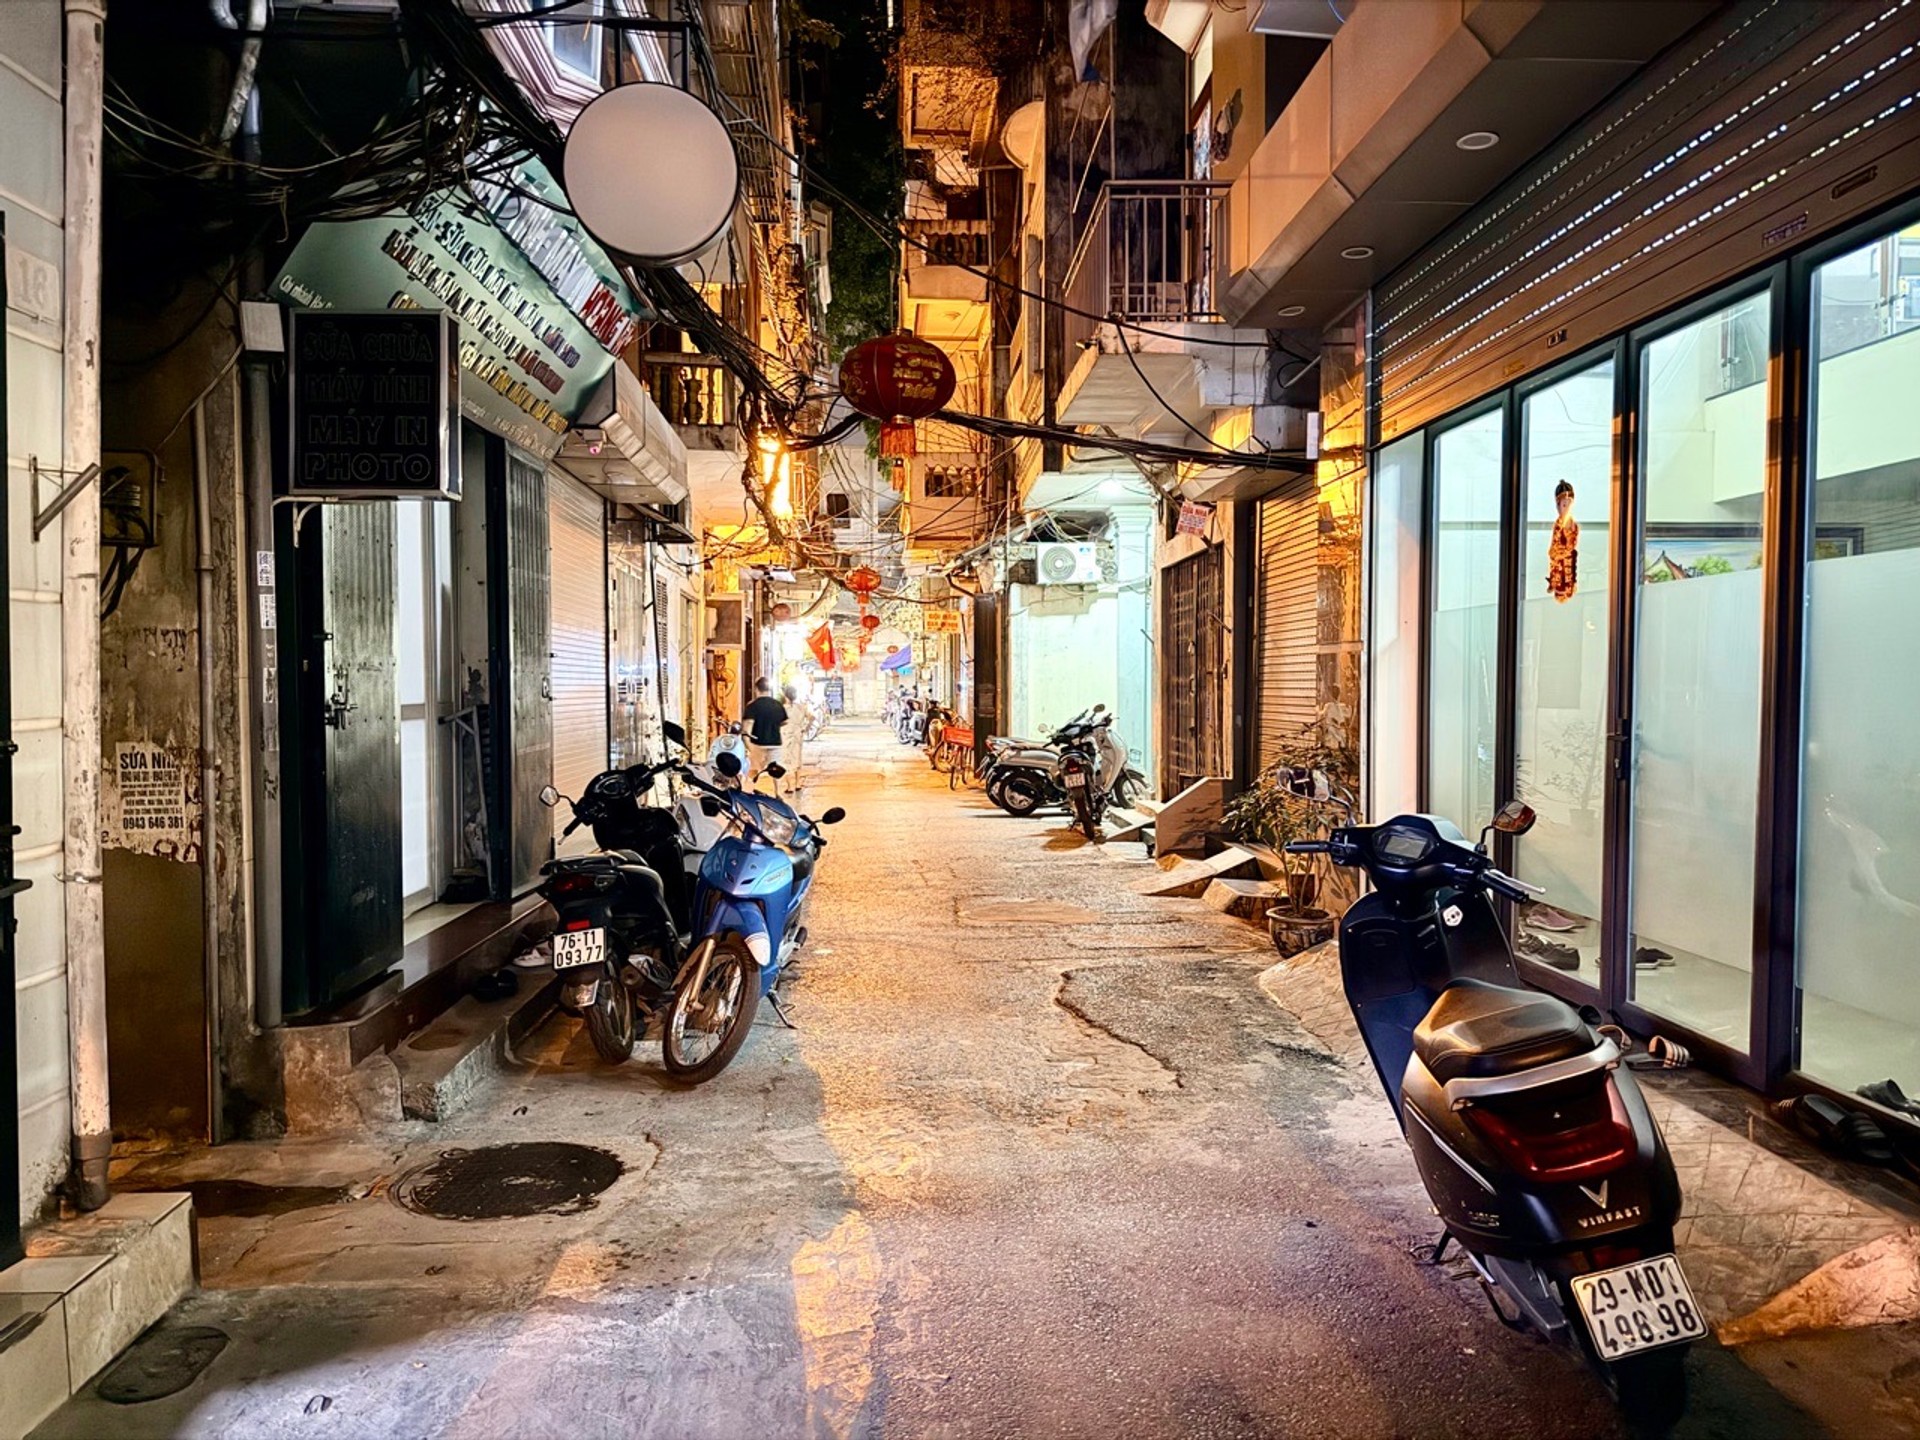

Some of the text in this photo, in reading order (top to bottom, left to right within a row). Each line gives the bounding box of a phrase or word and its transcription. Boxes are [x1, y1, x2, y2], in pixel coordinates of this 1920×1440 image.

[363, 322, 434, 362] CHỮA
[304, 367, 430, 403] MÁY TÍNH
[308, 408, 428, 446] MÁY IN
[304, 453, 431, 481] PHOTO
[120, 745, 148, 769] SỬA
[148, 816, 166, 830] 646
[561, 930, 595, 950] 76-T1
[556, 945, 602, 967] 093.77
[1578, 1206, 1641, 1228] VINFAST
[1583, 1261, 1679, 1315] 29-MD1
[1599, 1299, 1697, 1352] 498.98
